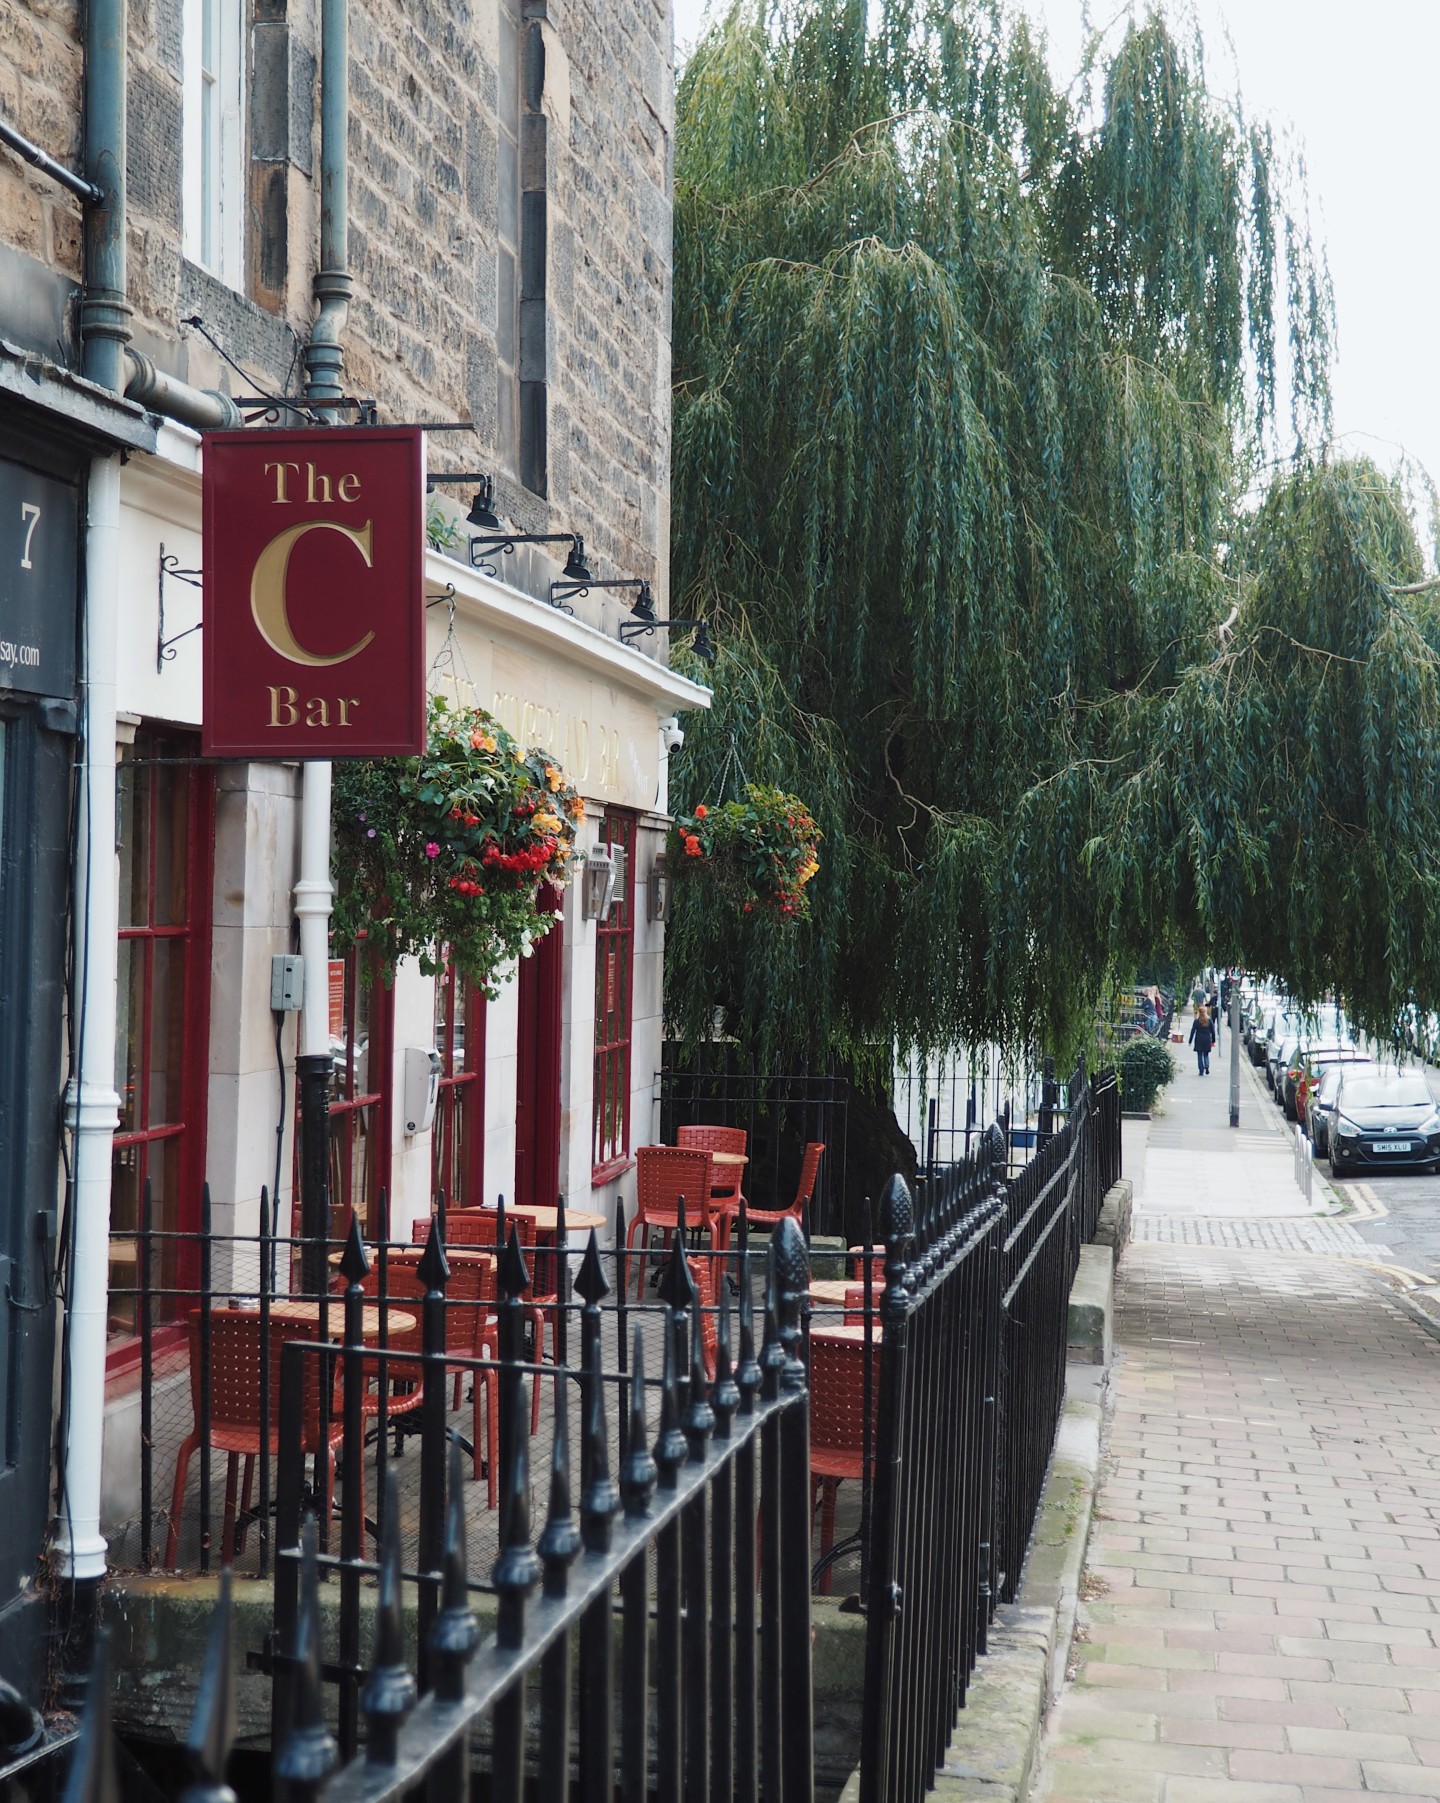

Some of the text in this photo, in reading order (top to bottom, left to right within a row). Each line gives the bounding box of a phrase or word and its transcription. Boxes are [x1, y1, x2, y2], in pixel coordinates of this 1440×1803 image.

[264, 461, 362, 504] The
[21, 501, 41, 570] 7
[250, 518, 376, 667] C
[0, 636, 40, 669] say.com
[265, 686, 361, 727] Bar
[599, 725, 621, 792] BAR
